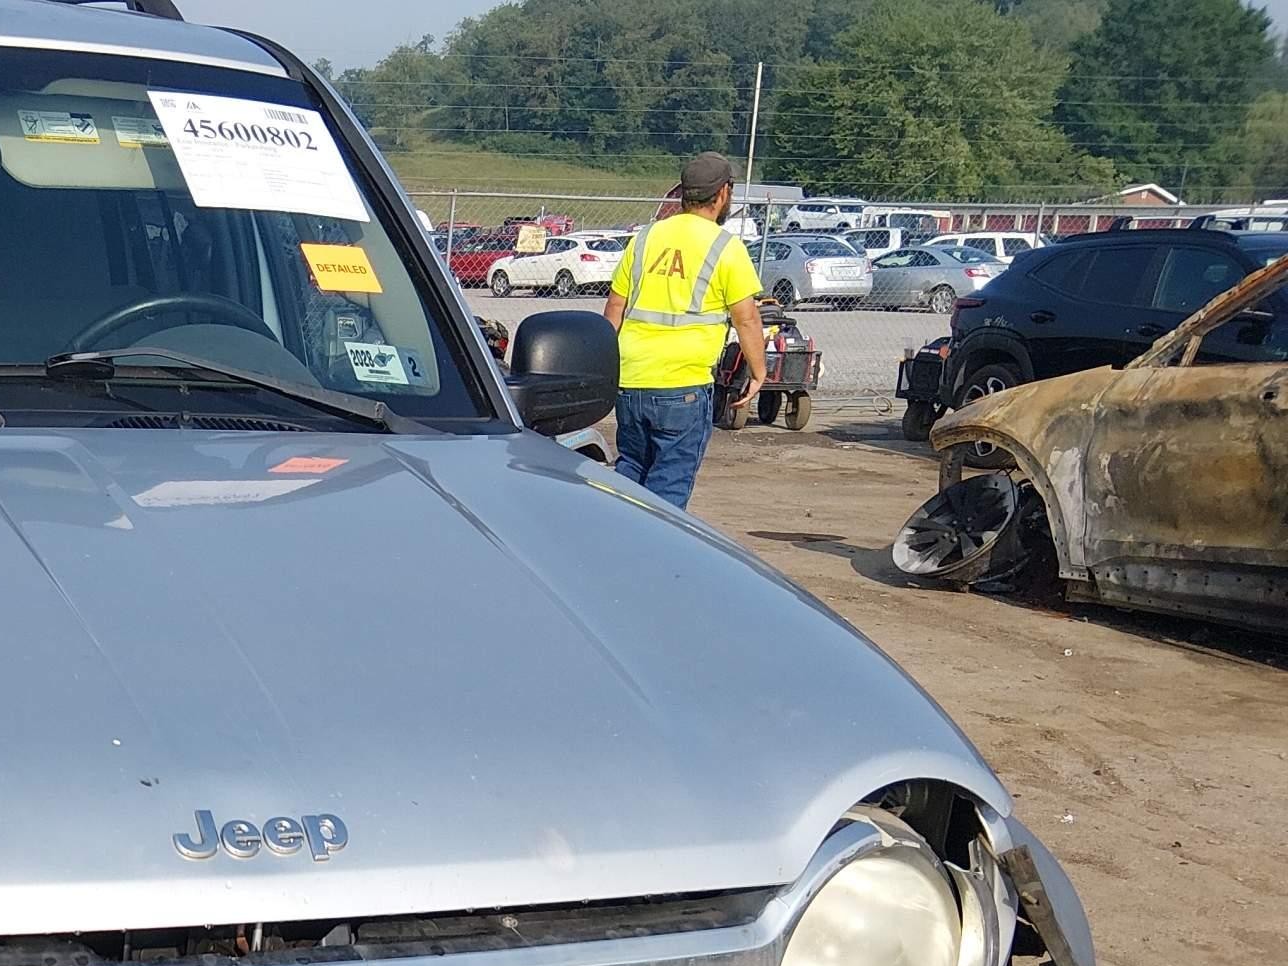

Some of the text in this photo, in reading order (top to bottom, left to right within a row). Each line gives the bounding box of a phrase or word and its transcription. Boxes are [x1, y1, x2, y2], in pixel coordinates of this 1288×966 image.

[183, 117, 318, 151] 45600802
[316, 263, 368, 275] DETAILED
[350, 349, 375, 368] 2028
[407, 356, 422, 377] 2
[172, 809, 349, 862] Jeep
